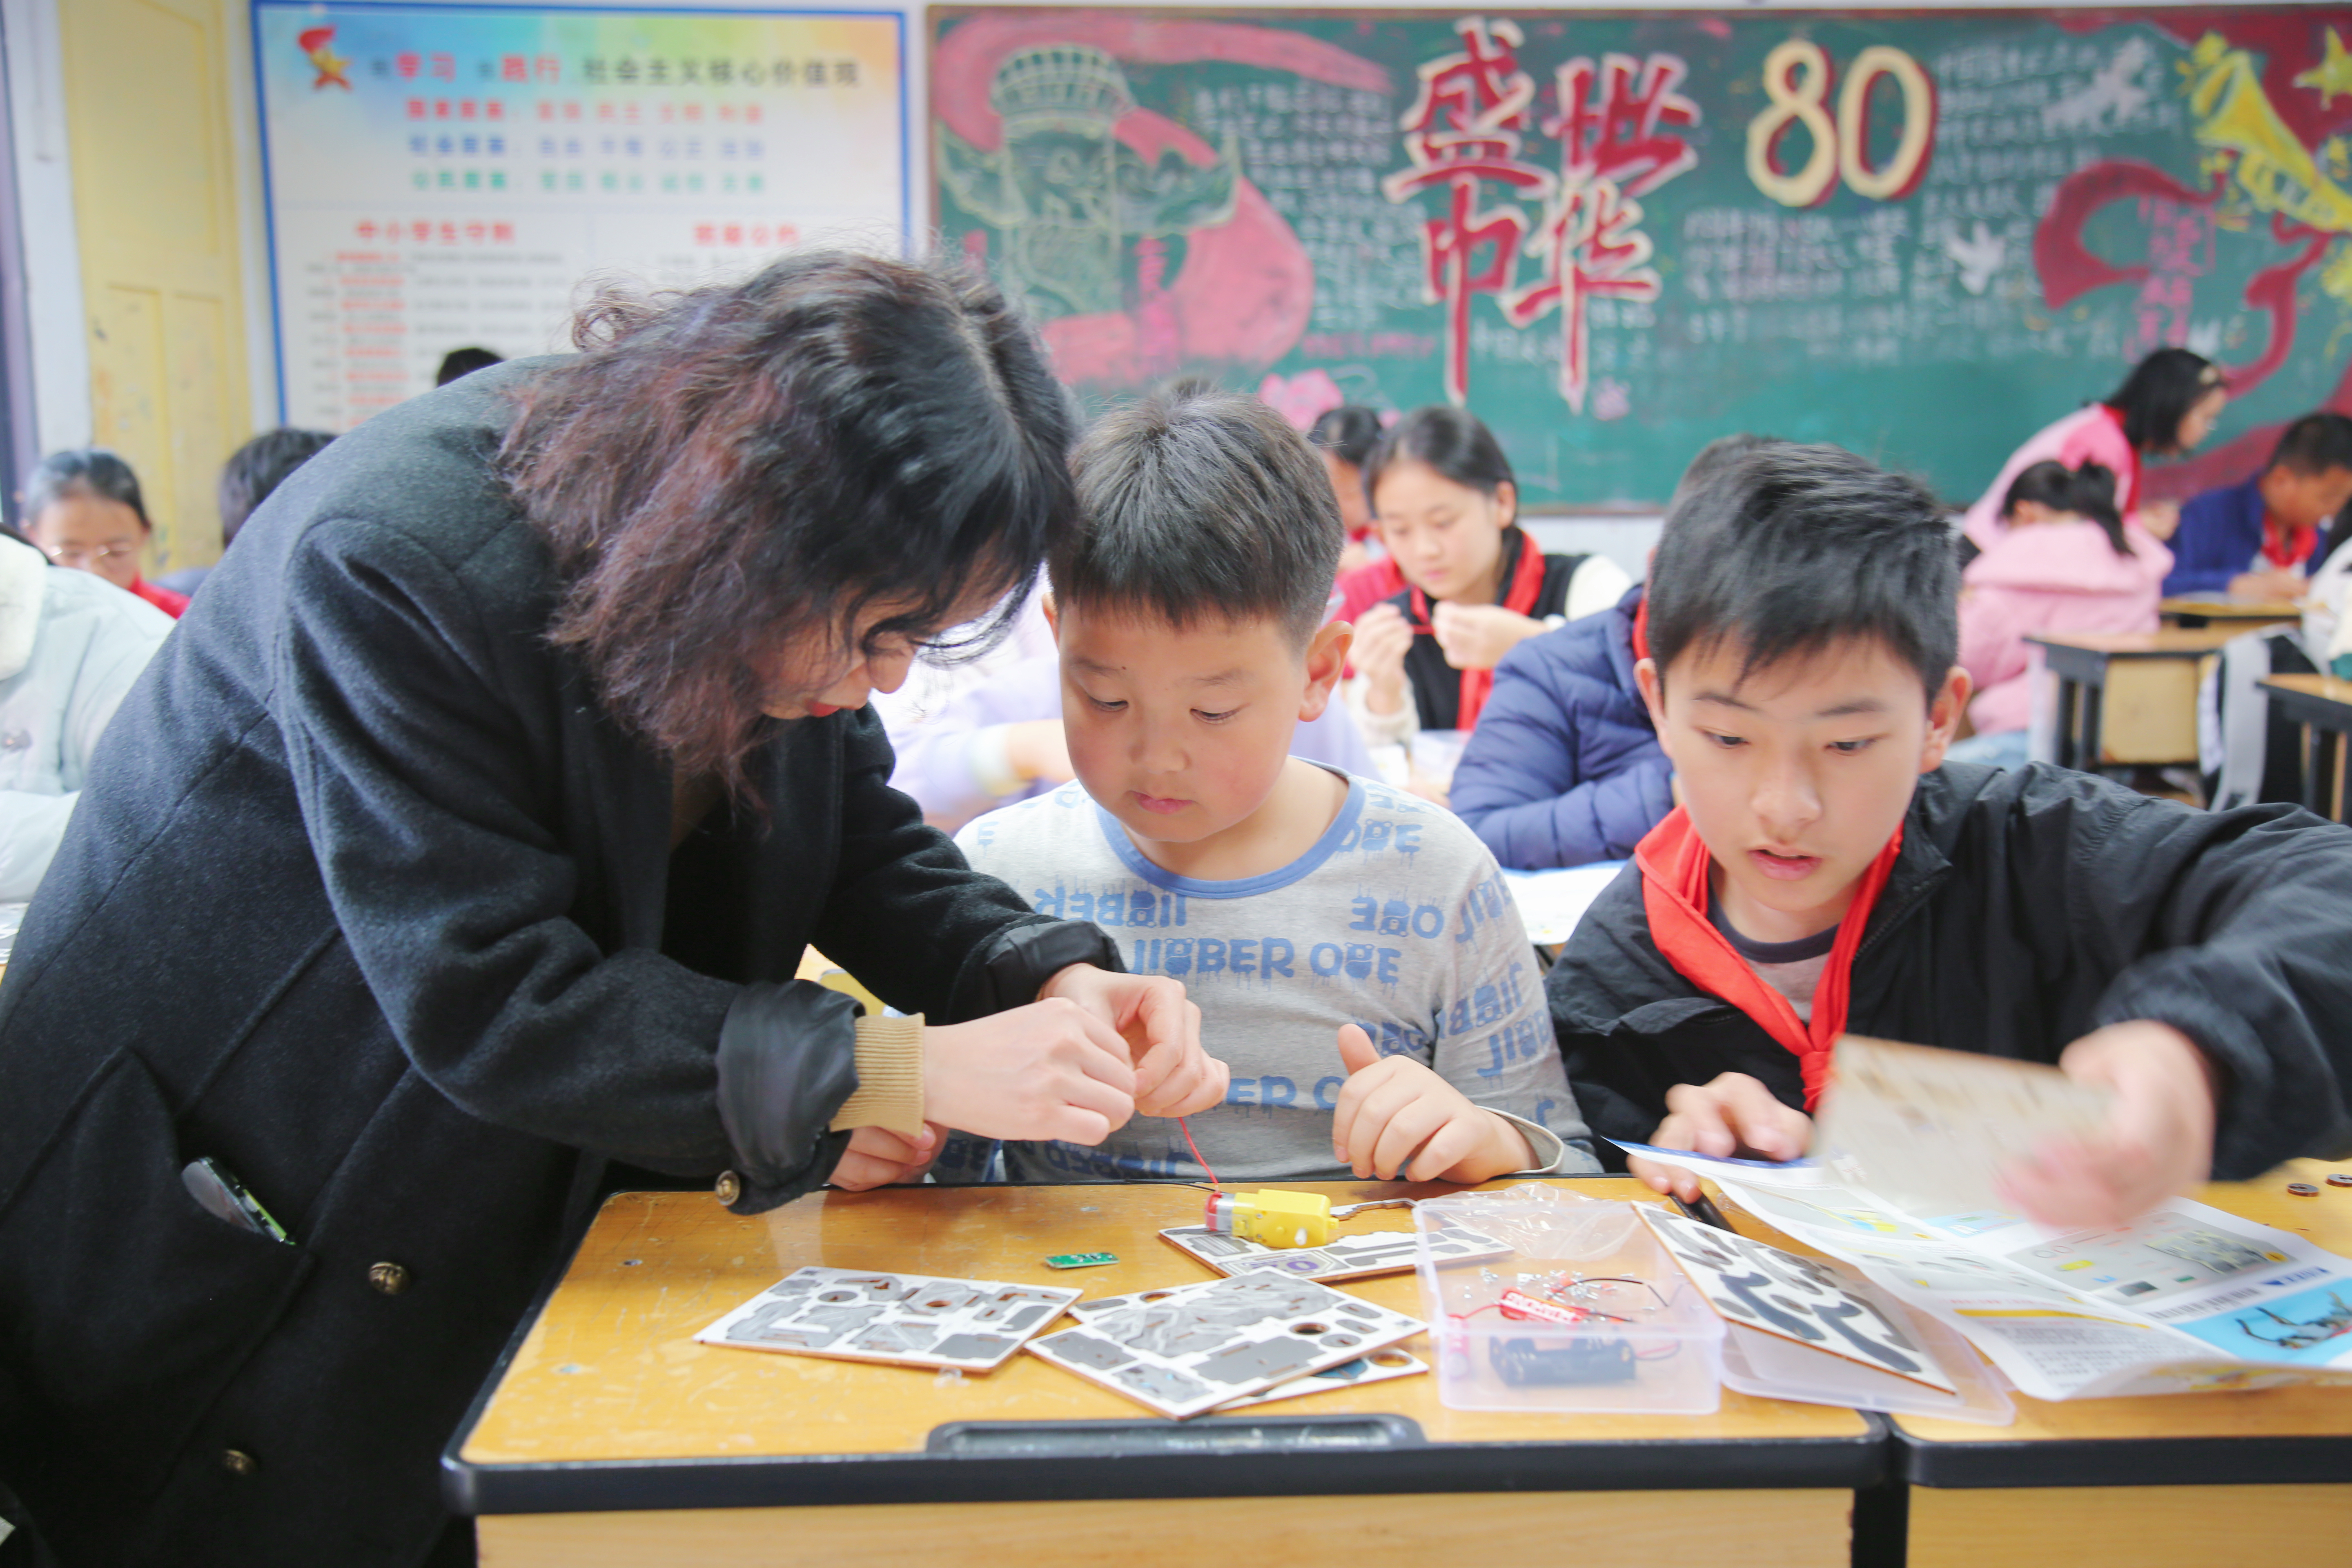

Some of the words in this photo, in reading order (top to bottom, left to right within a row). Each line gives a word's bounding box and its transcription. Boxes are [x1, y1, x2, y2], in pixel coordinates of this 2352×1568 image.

[583, 56, 860, 86] 社会主义核心价值观
[1381, 16, 1701, 203] 盛世
[1746, 38, 1939, 207] 80
[1418, 172, 1662, 414] 中华
